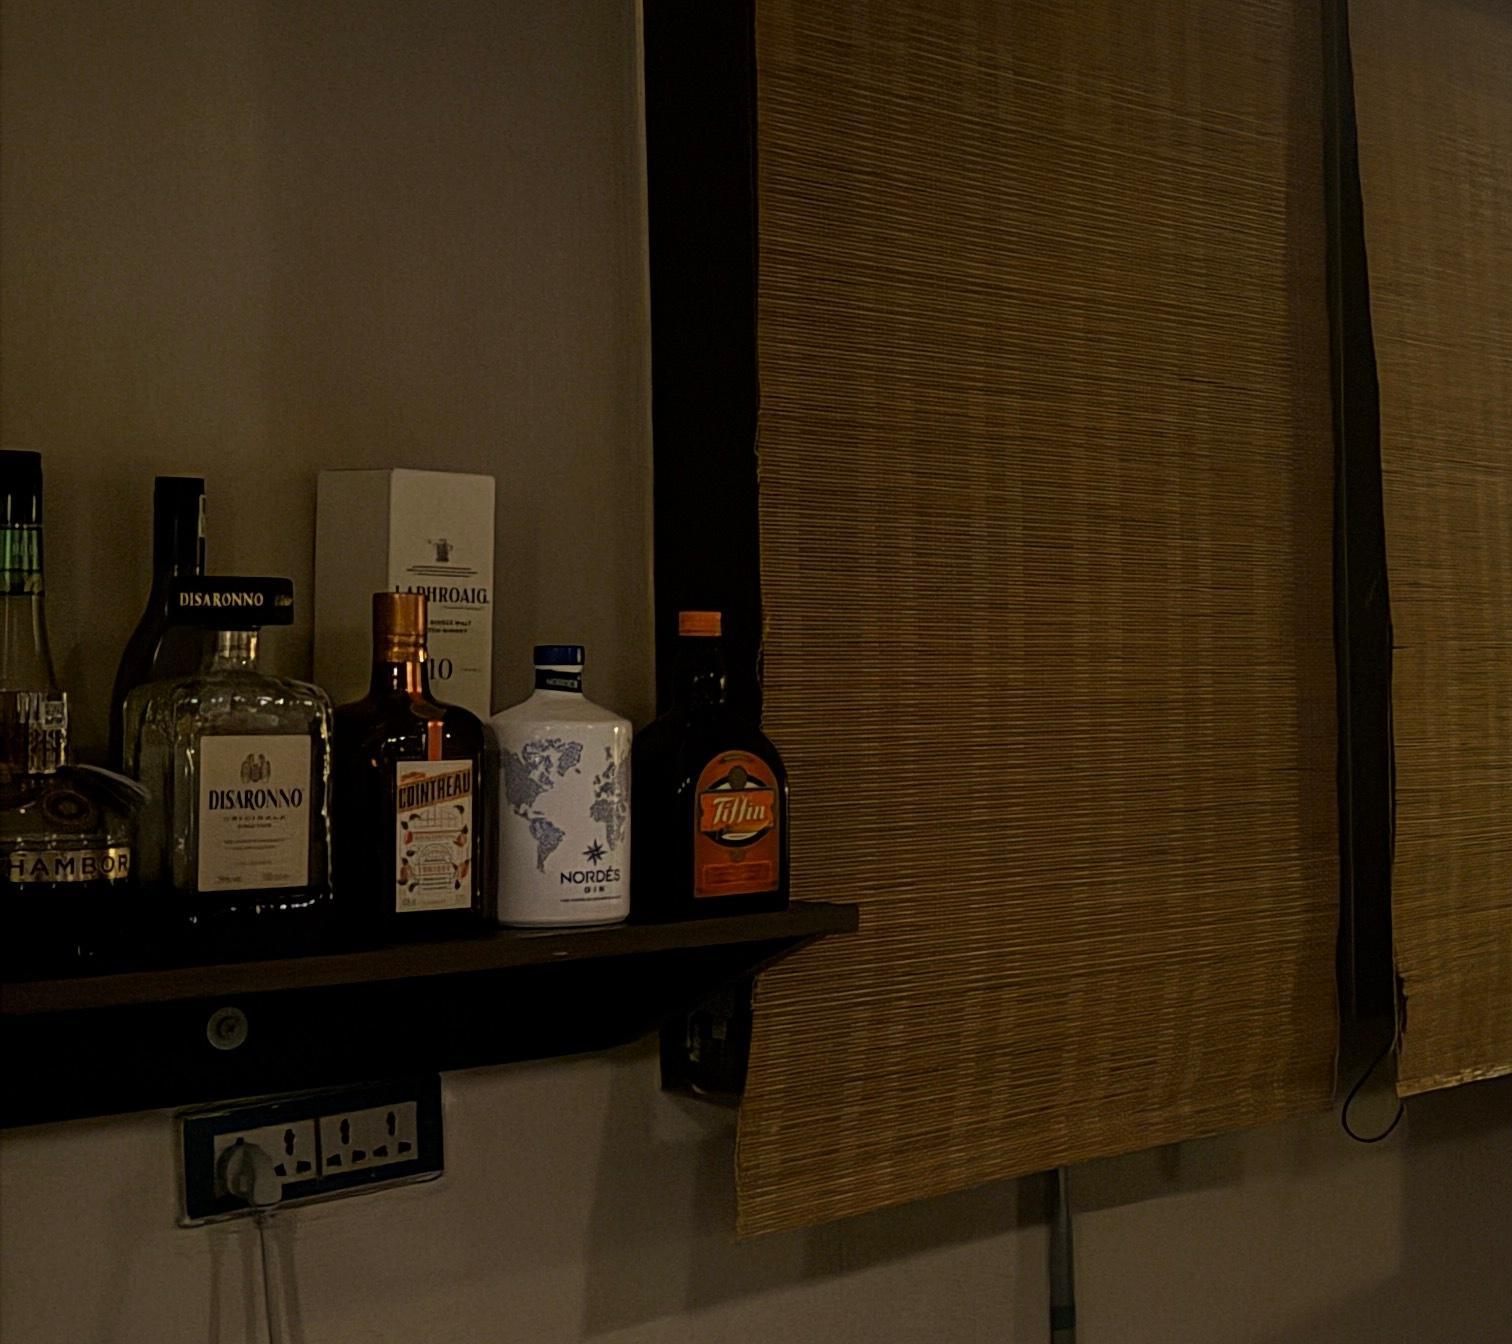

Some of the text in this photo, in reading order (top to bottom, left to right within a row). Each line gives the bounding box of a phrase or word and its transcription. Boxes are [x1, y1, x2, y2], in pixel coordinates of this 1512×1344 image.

[179, 591, 264, 607] DISARONNO
[209, 788, 303, 810] DISARONNO
[399, 768, 471, 809] COINTREAU
[713, 795, 766, 825] Tiffin
[560, 865, 621, 884] NORDÉS
